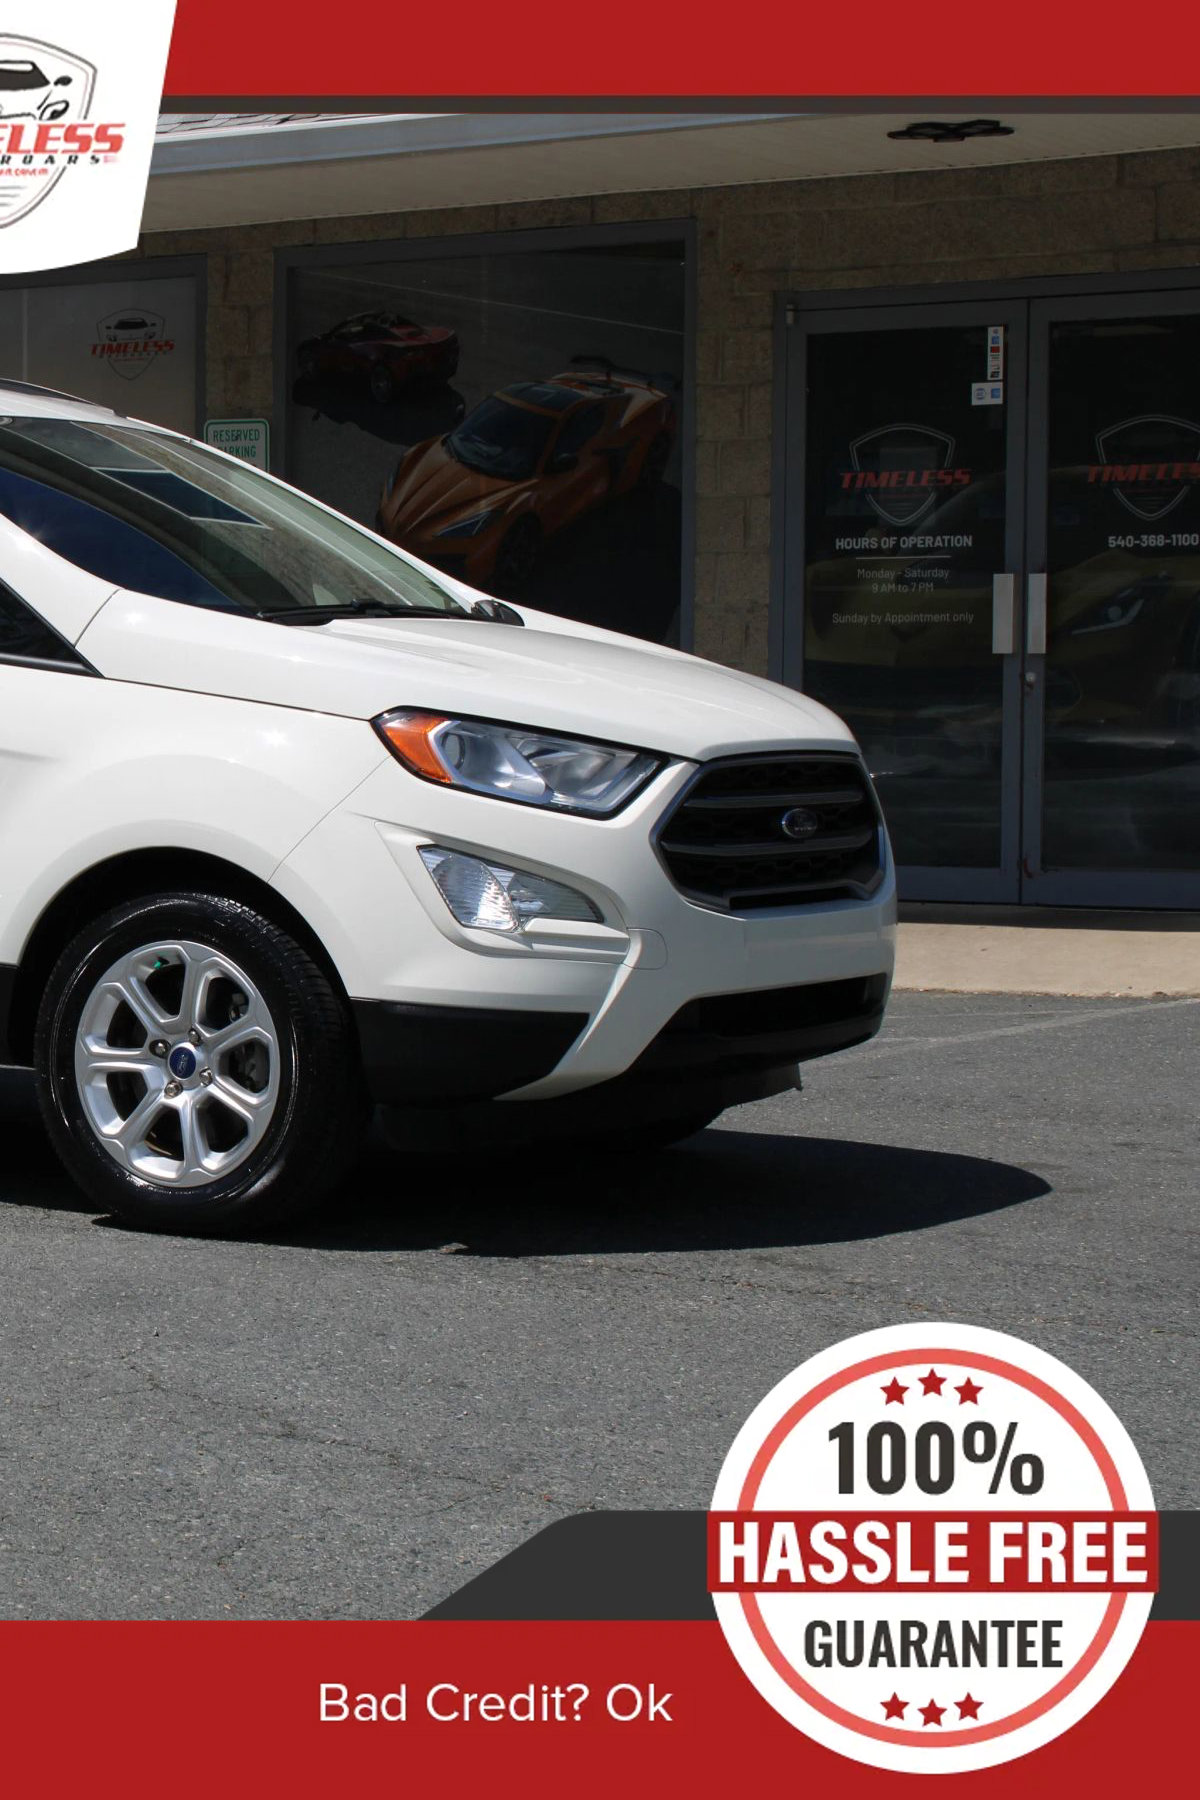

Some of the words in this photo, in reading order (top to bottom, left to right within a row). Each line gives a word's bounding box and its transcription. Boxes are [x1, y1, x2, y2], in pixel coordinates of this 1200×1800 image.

[90, 339, 175, 356] TIMELESS
[212, 429, 260, 442] RESERVED
[217, 445, 257, 458] ARKING
[840, 469, 973, 488] TIMELESS
[1086, 463, 1200, 483] TIMELES
[835, 537, 878, 550] HOURS
[880, 536, 898, 549] OF
[900, 535, 973, 548] OPERATION
[1107, 534, 1200, 548] 540-368-1100
[857, 568, 896, 580] Monday
[904, 567, 950, 580] Saturday
[880, 583, 896, 593] AM
[897, 583, 909, 593] to
[918, 582, 934, 593] PM
[832, 613, 869, 625] Sunday
[870, 613, 882, 625] by
[885, 612, 951, 624] Appointment
[952, 612, 975, 624] only
